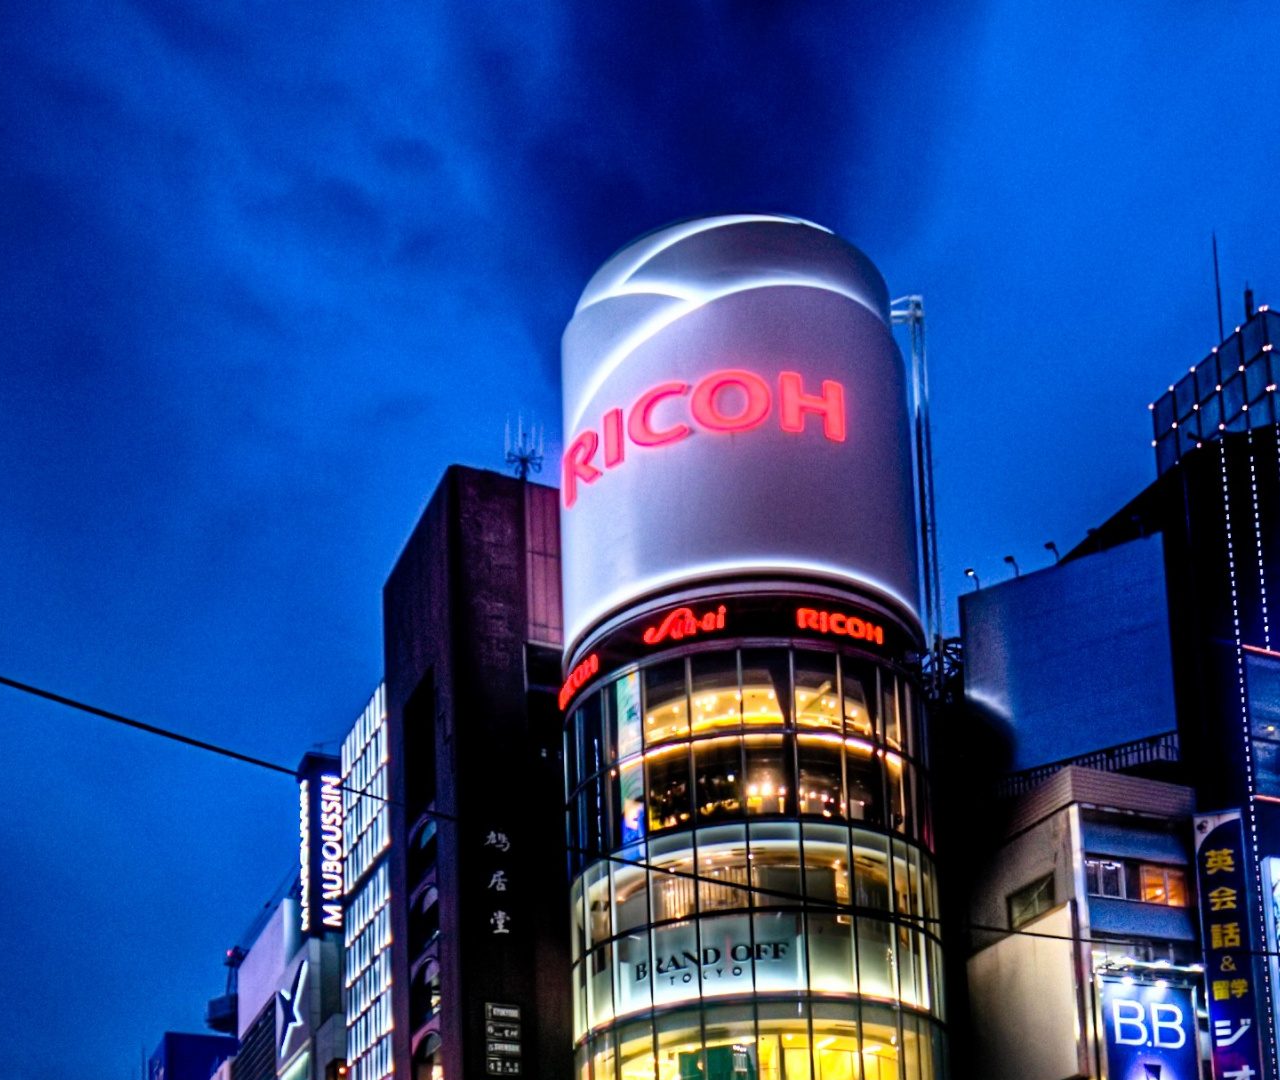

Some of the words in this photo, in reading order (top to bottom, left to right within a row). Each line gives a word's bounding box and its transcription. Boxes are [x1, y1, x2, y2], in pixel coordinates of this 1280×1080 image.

[560, 367, 848, 511] RICOH
[796, 607, 885, 645] RICOH
[320, 774, 343, 927] MAUBOUSSIN
[634, 947, 722, 982] BRAND
[730, 941, 790, 962] OFF
